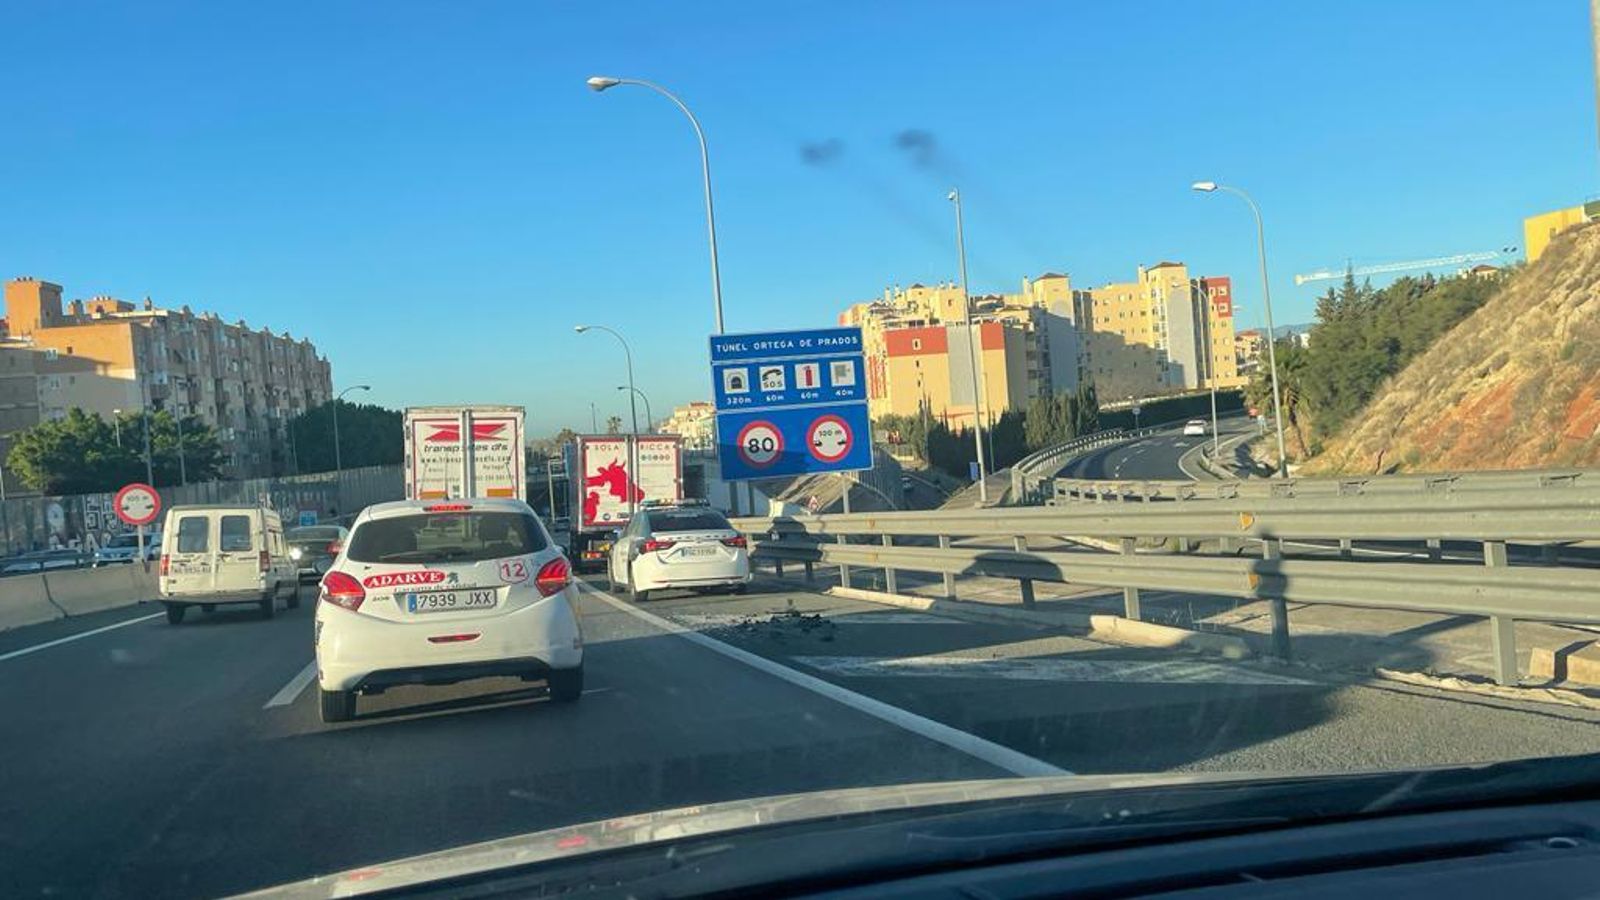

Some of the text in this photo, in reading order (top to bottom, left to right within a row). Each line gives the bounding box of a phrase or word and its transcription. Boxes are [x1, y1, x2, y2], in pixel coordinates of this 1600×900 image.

[716, 335, 858, 353] TÚNEL ORTEGA DE PRADOS
[763, 380, 782, 389] SOS
[748, 436, 775, 454] 80
[502, 562, 525, 577] 12
[367, 570, 441, 588] ADARVE
[419, 591, 492, 608] 7939 JXX
